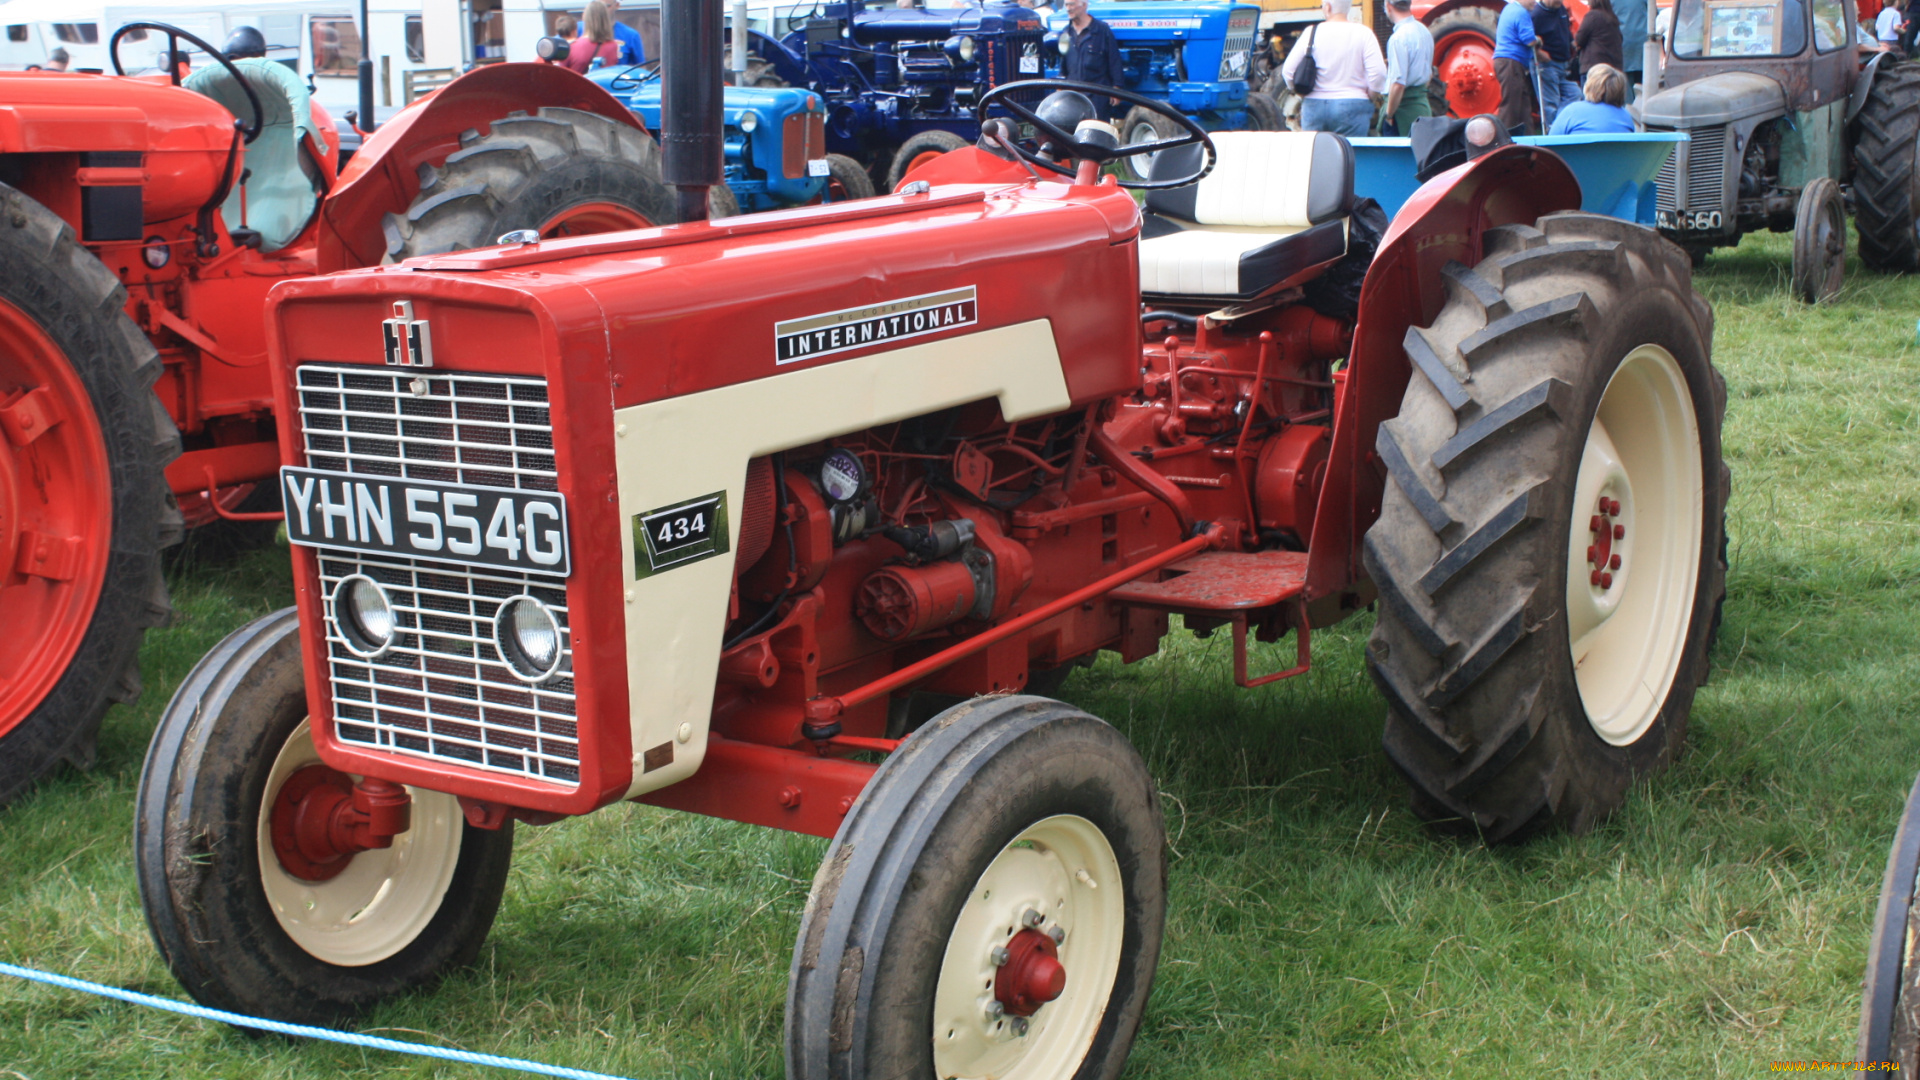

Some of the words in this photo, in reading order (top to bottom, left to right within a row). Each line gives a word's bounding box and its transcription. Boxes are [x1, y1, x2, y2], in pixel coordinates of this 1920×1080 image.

[788, 304, 967, 357] INTERNATIONAL
[285, 475, 394, 546] YHN
[405, 487, 562, 565] 554G
[657, 511, 706, 543] 434
